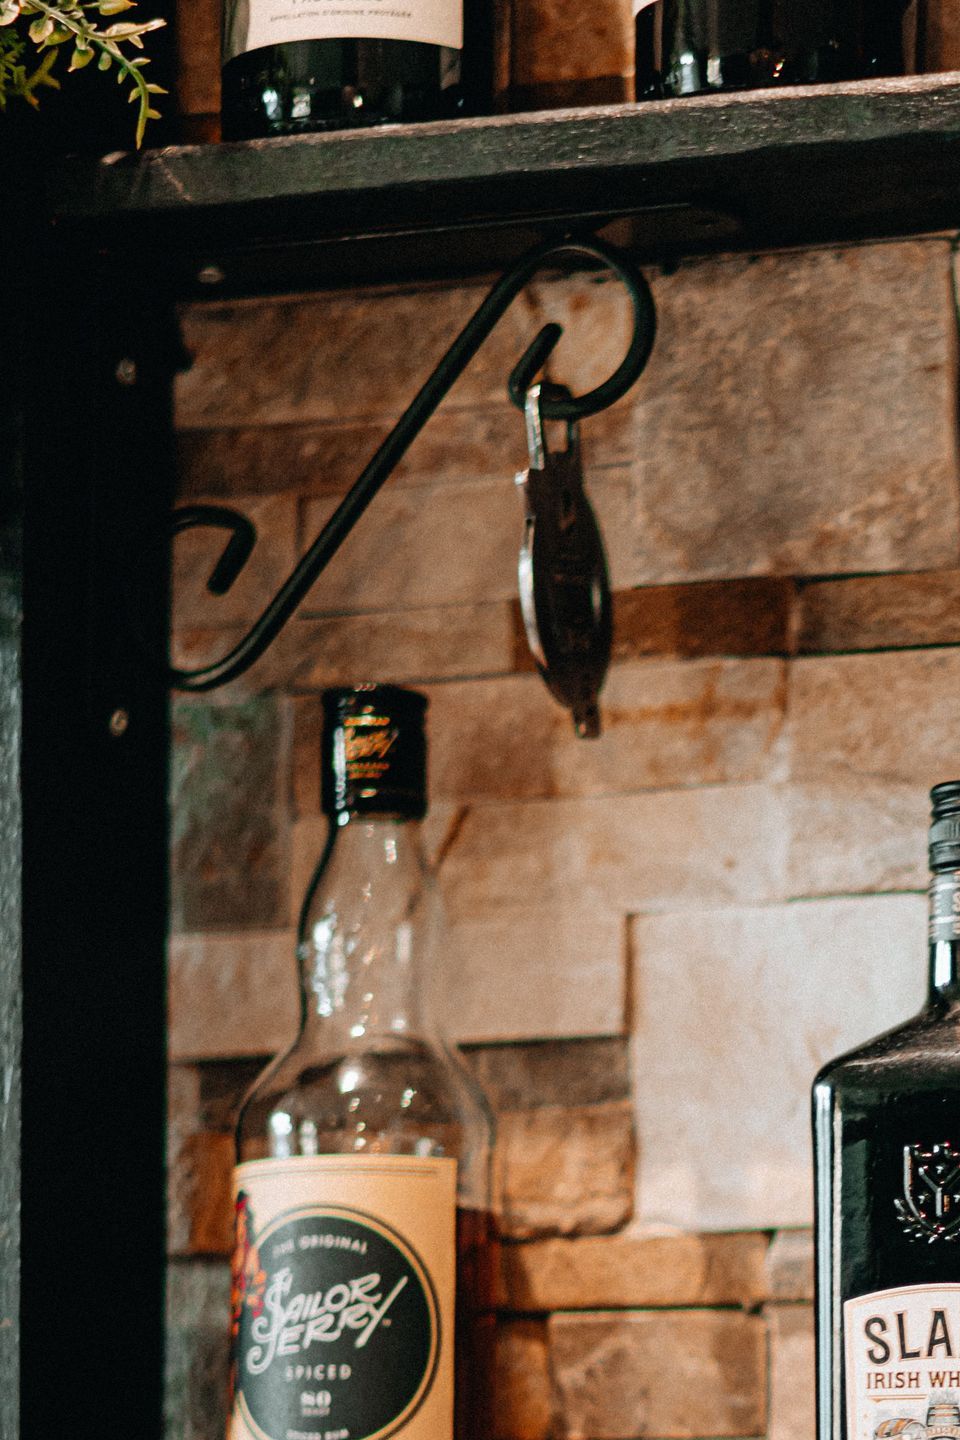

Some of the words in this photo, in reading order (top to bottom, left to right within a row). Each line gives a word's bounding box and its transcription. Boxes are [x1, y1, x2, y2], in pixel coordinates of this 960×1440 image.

[298, 1233, 367, 1255] ORIGINAL
[246, 1276, 408, 1375] JERRY
[286, 1363, 351, 1382] SPICED
[866, 1371, 921, 1389] IRISH
